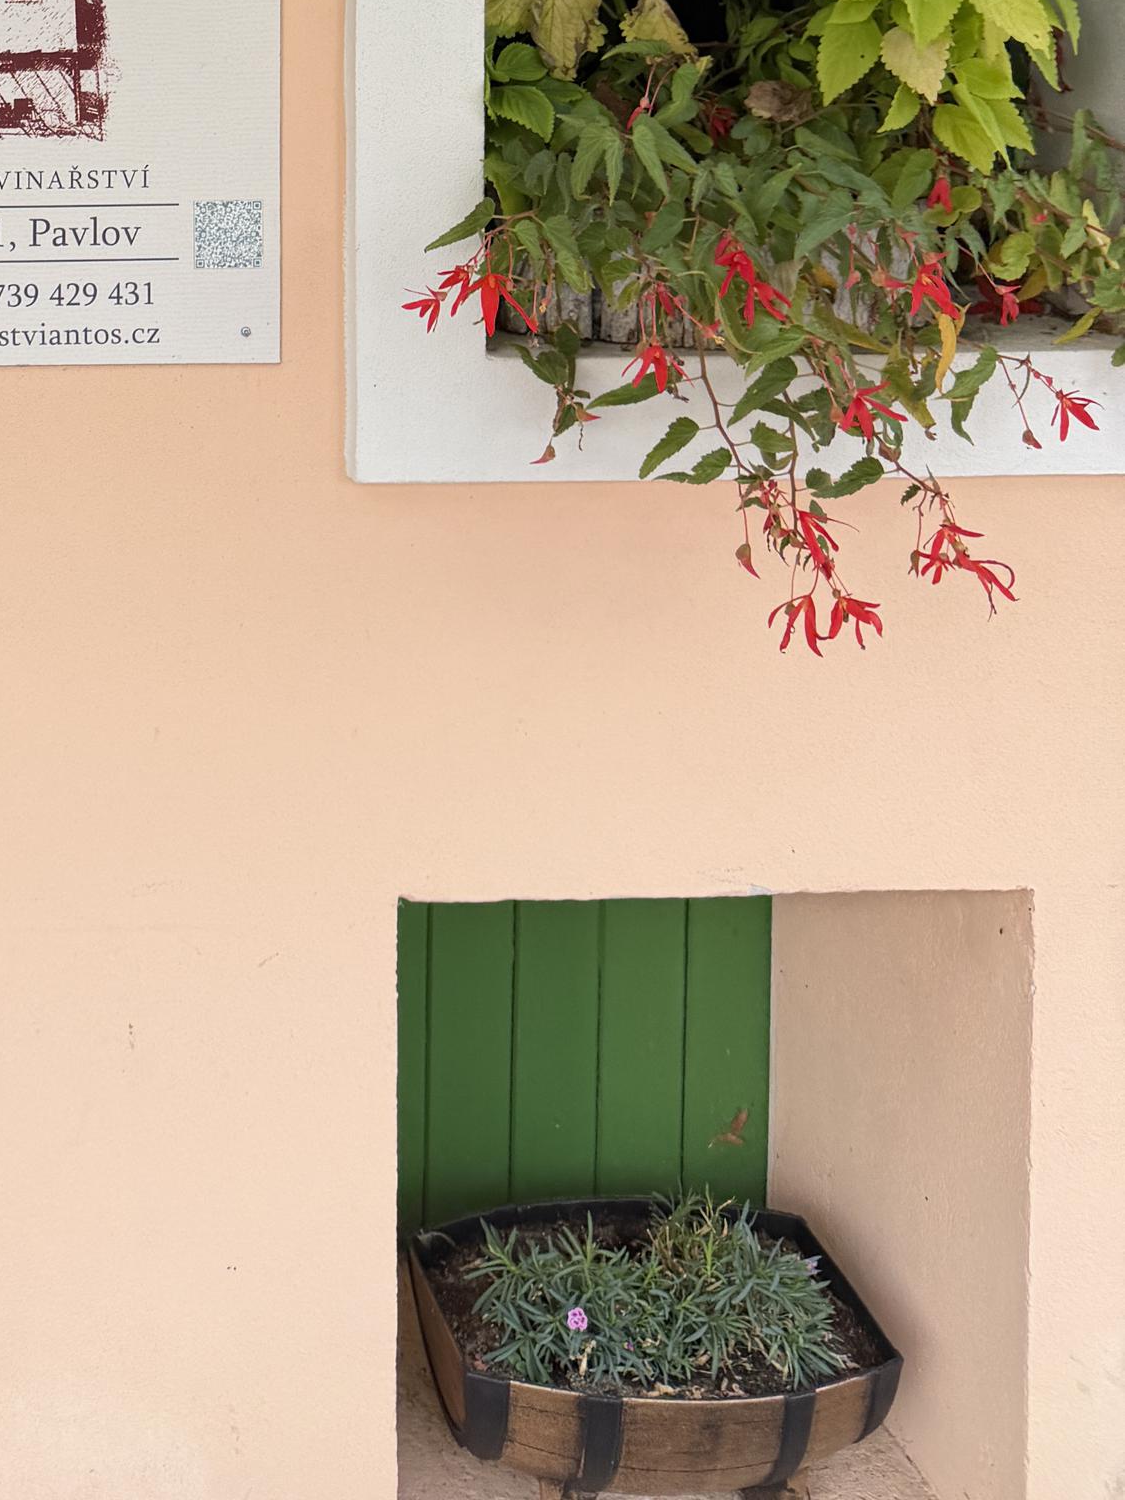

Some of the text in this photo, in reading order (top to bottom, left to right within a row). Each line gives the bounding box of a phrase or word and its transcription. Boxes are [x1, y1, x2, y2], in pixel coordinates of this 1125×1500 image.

[28, 216, 142, 248] Pavlov
[49, 282, 99, 308] 429
[107, 281, 154, 306] 431
